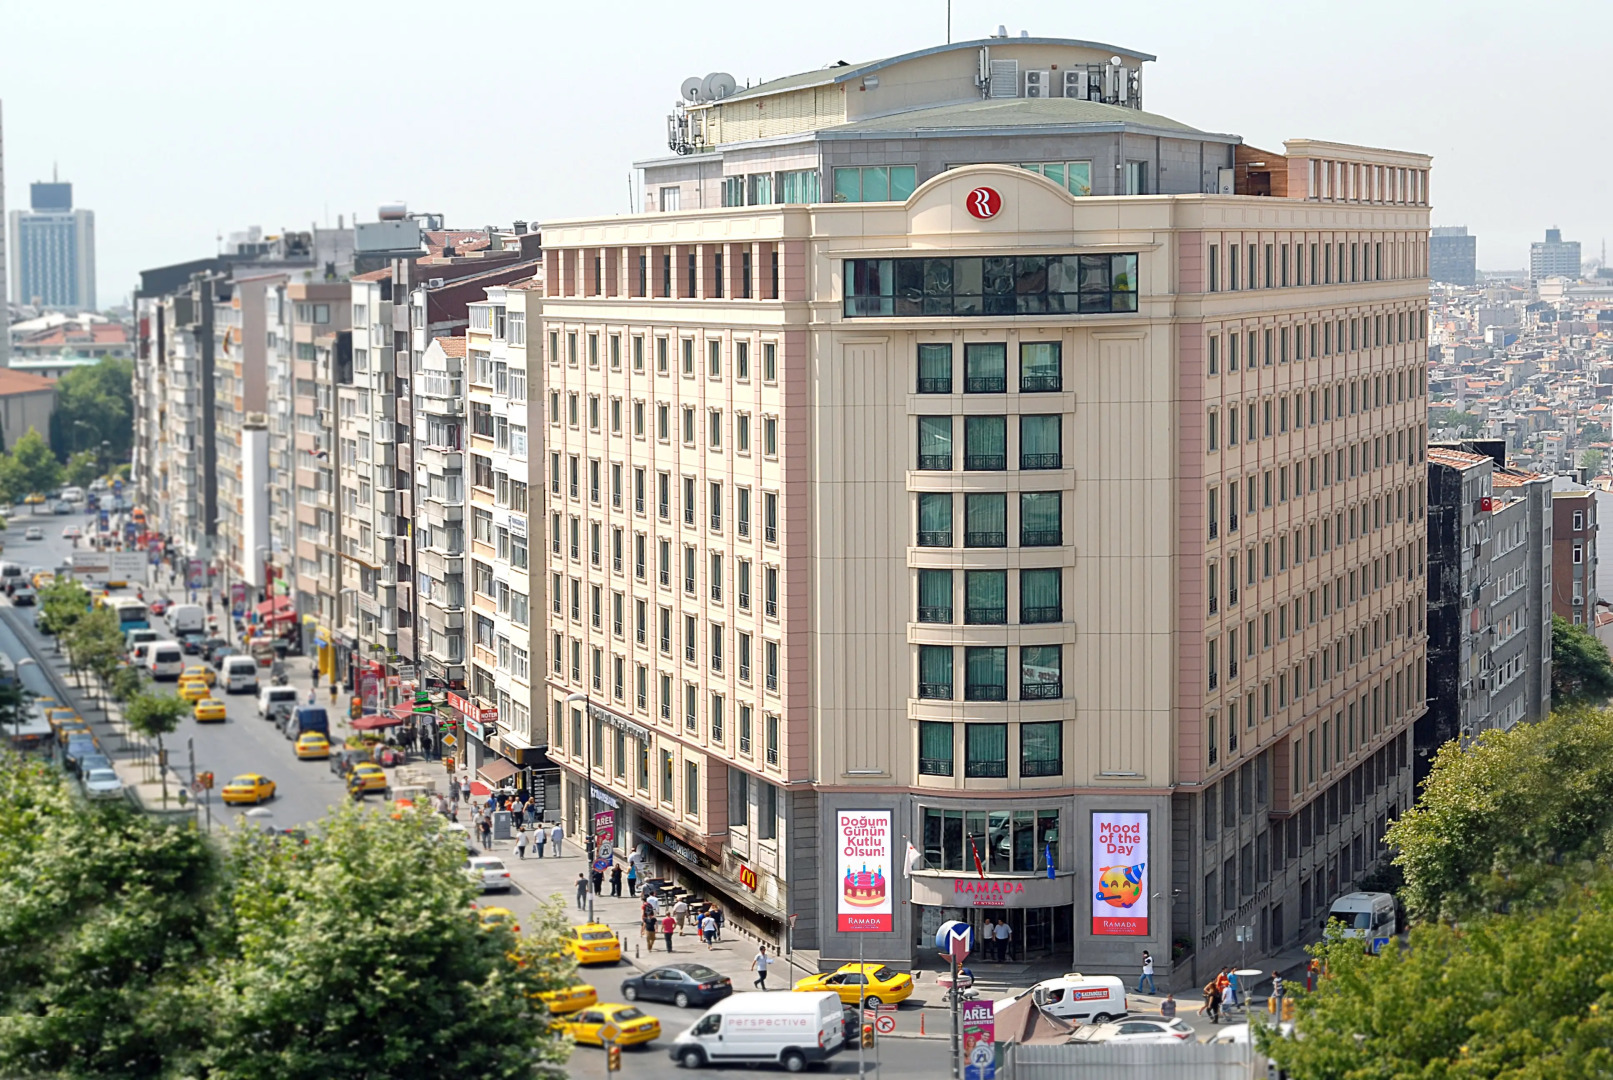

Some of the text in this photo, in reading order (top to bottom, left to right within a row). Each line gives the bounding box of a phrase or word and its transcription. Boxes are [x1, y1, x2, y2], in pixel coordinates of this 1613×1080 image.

[596, 816, 614, 827] AREL
[841, 816, 888, 828] Doğum
[843, 826, 885, 837] Günün
[1100, 822, 1140, 833] Mood
[847, 836, 882, 847] Kutlu
[1099, 832, 1141, 844] of the
[844, 846, 885, 857] Olsun!
[1107, 843, 1133, 856] Day
[954, 878, 1024, 893] RAMADA
[1103, 920, 1137, 928] RAMADA
[963, 1008, 994, 1021] AREL
